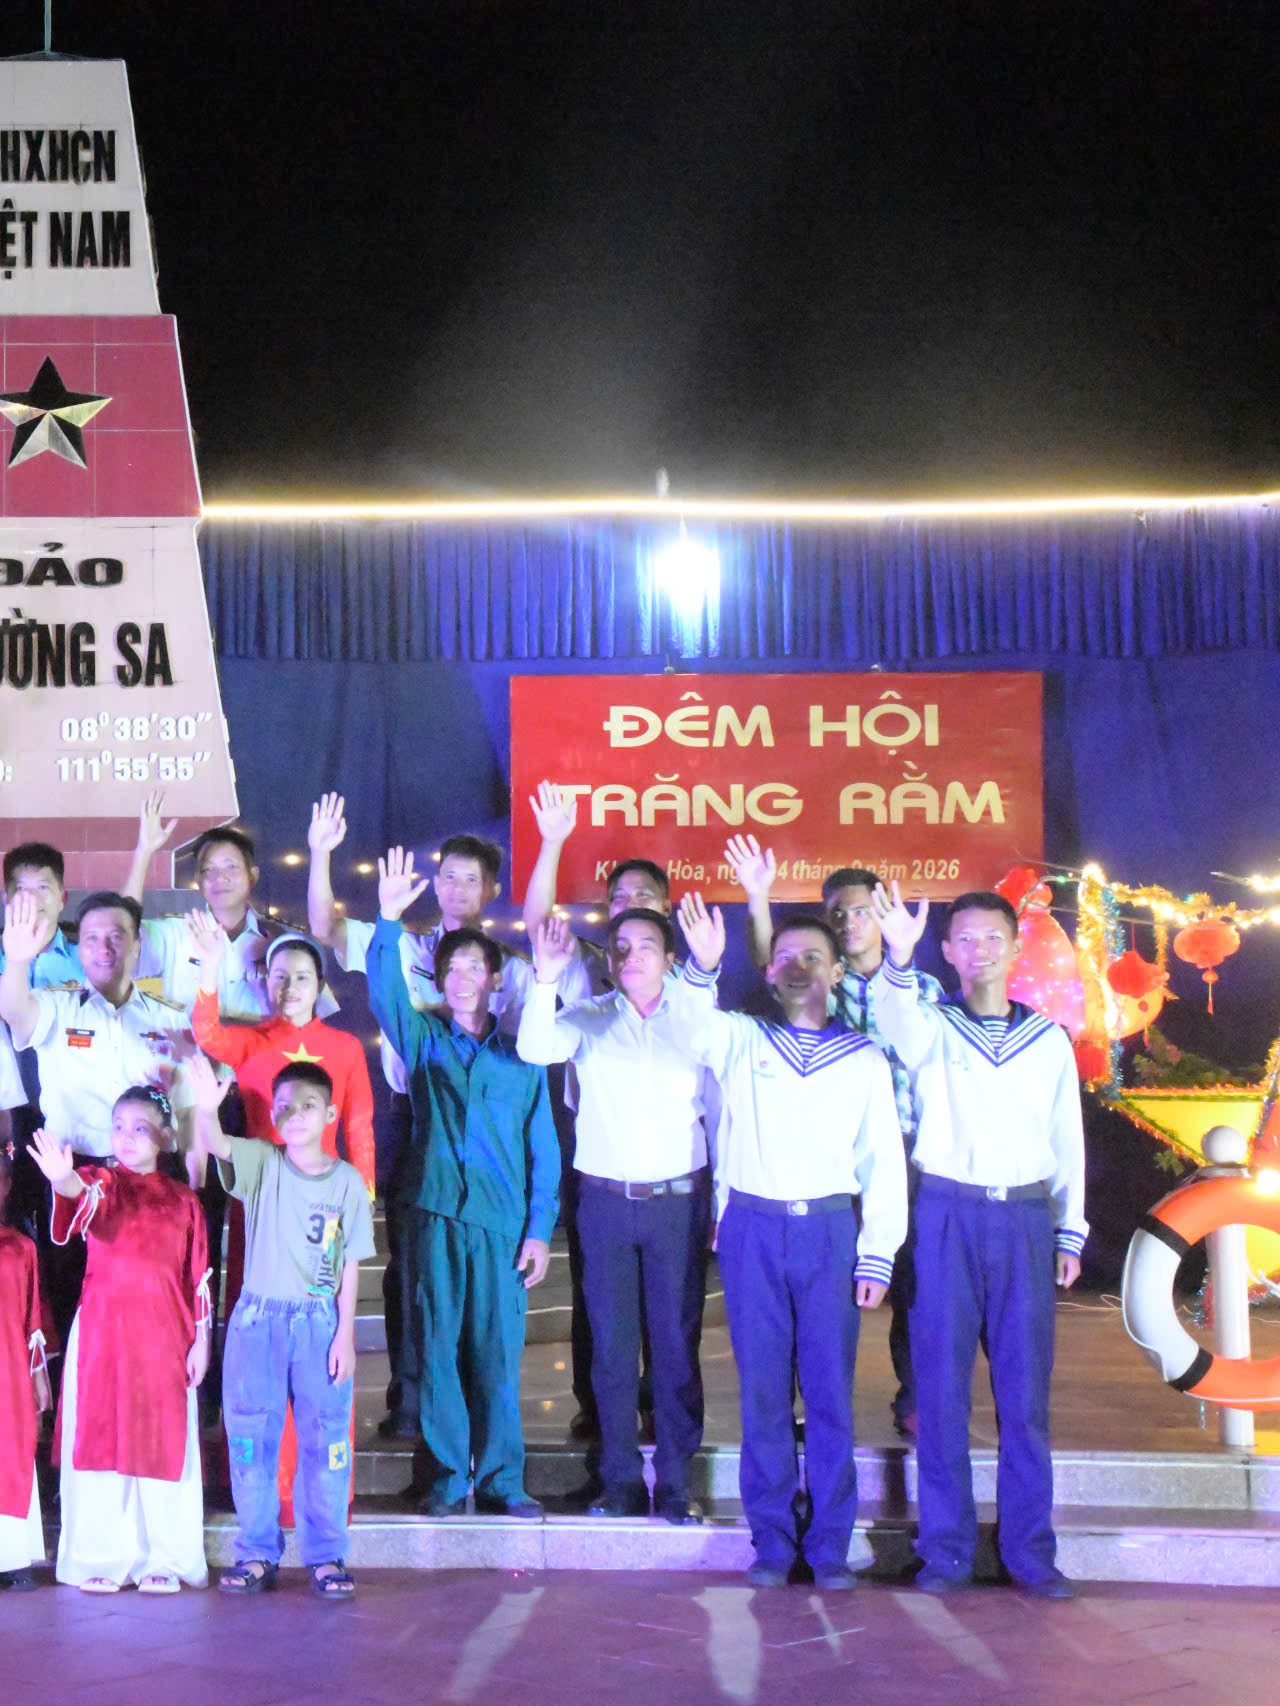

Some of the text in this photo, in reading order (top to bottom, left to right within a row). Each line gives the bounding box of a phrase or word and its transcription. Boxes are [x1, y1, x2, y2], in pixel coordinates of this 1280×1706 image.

[49, 210, 131, 267] NAM
[116, 622, 174, 688] SA
[602, 690, 939, 756] ĐÊM HỘI
[839, 760, 1006, 825] RẰM
[667, 859, 711, 885] Hòa,
[911, 859, 961, 881] 2026
